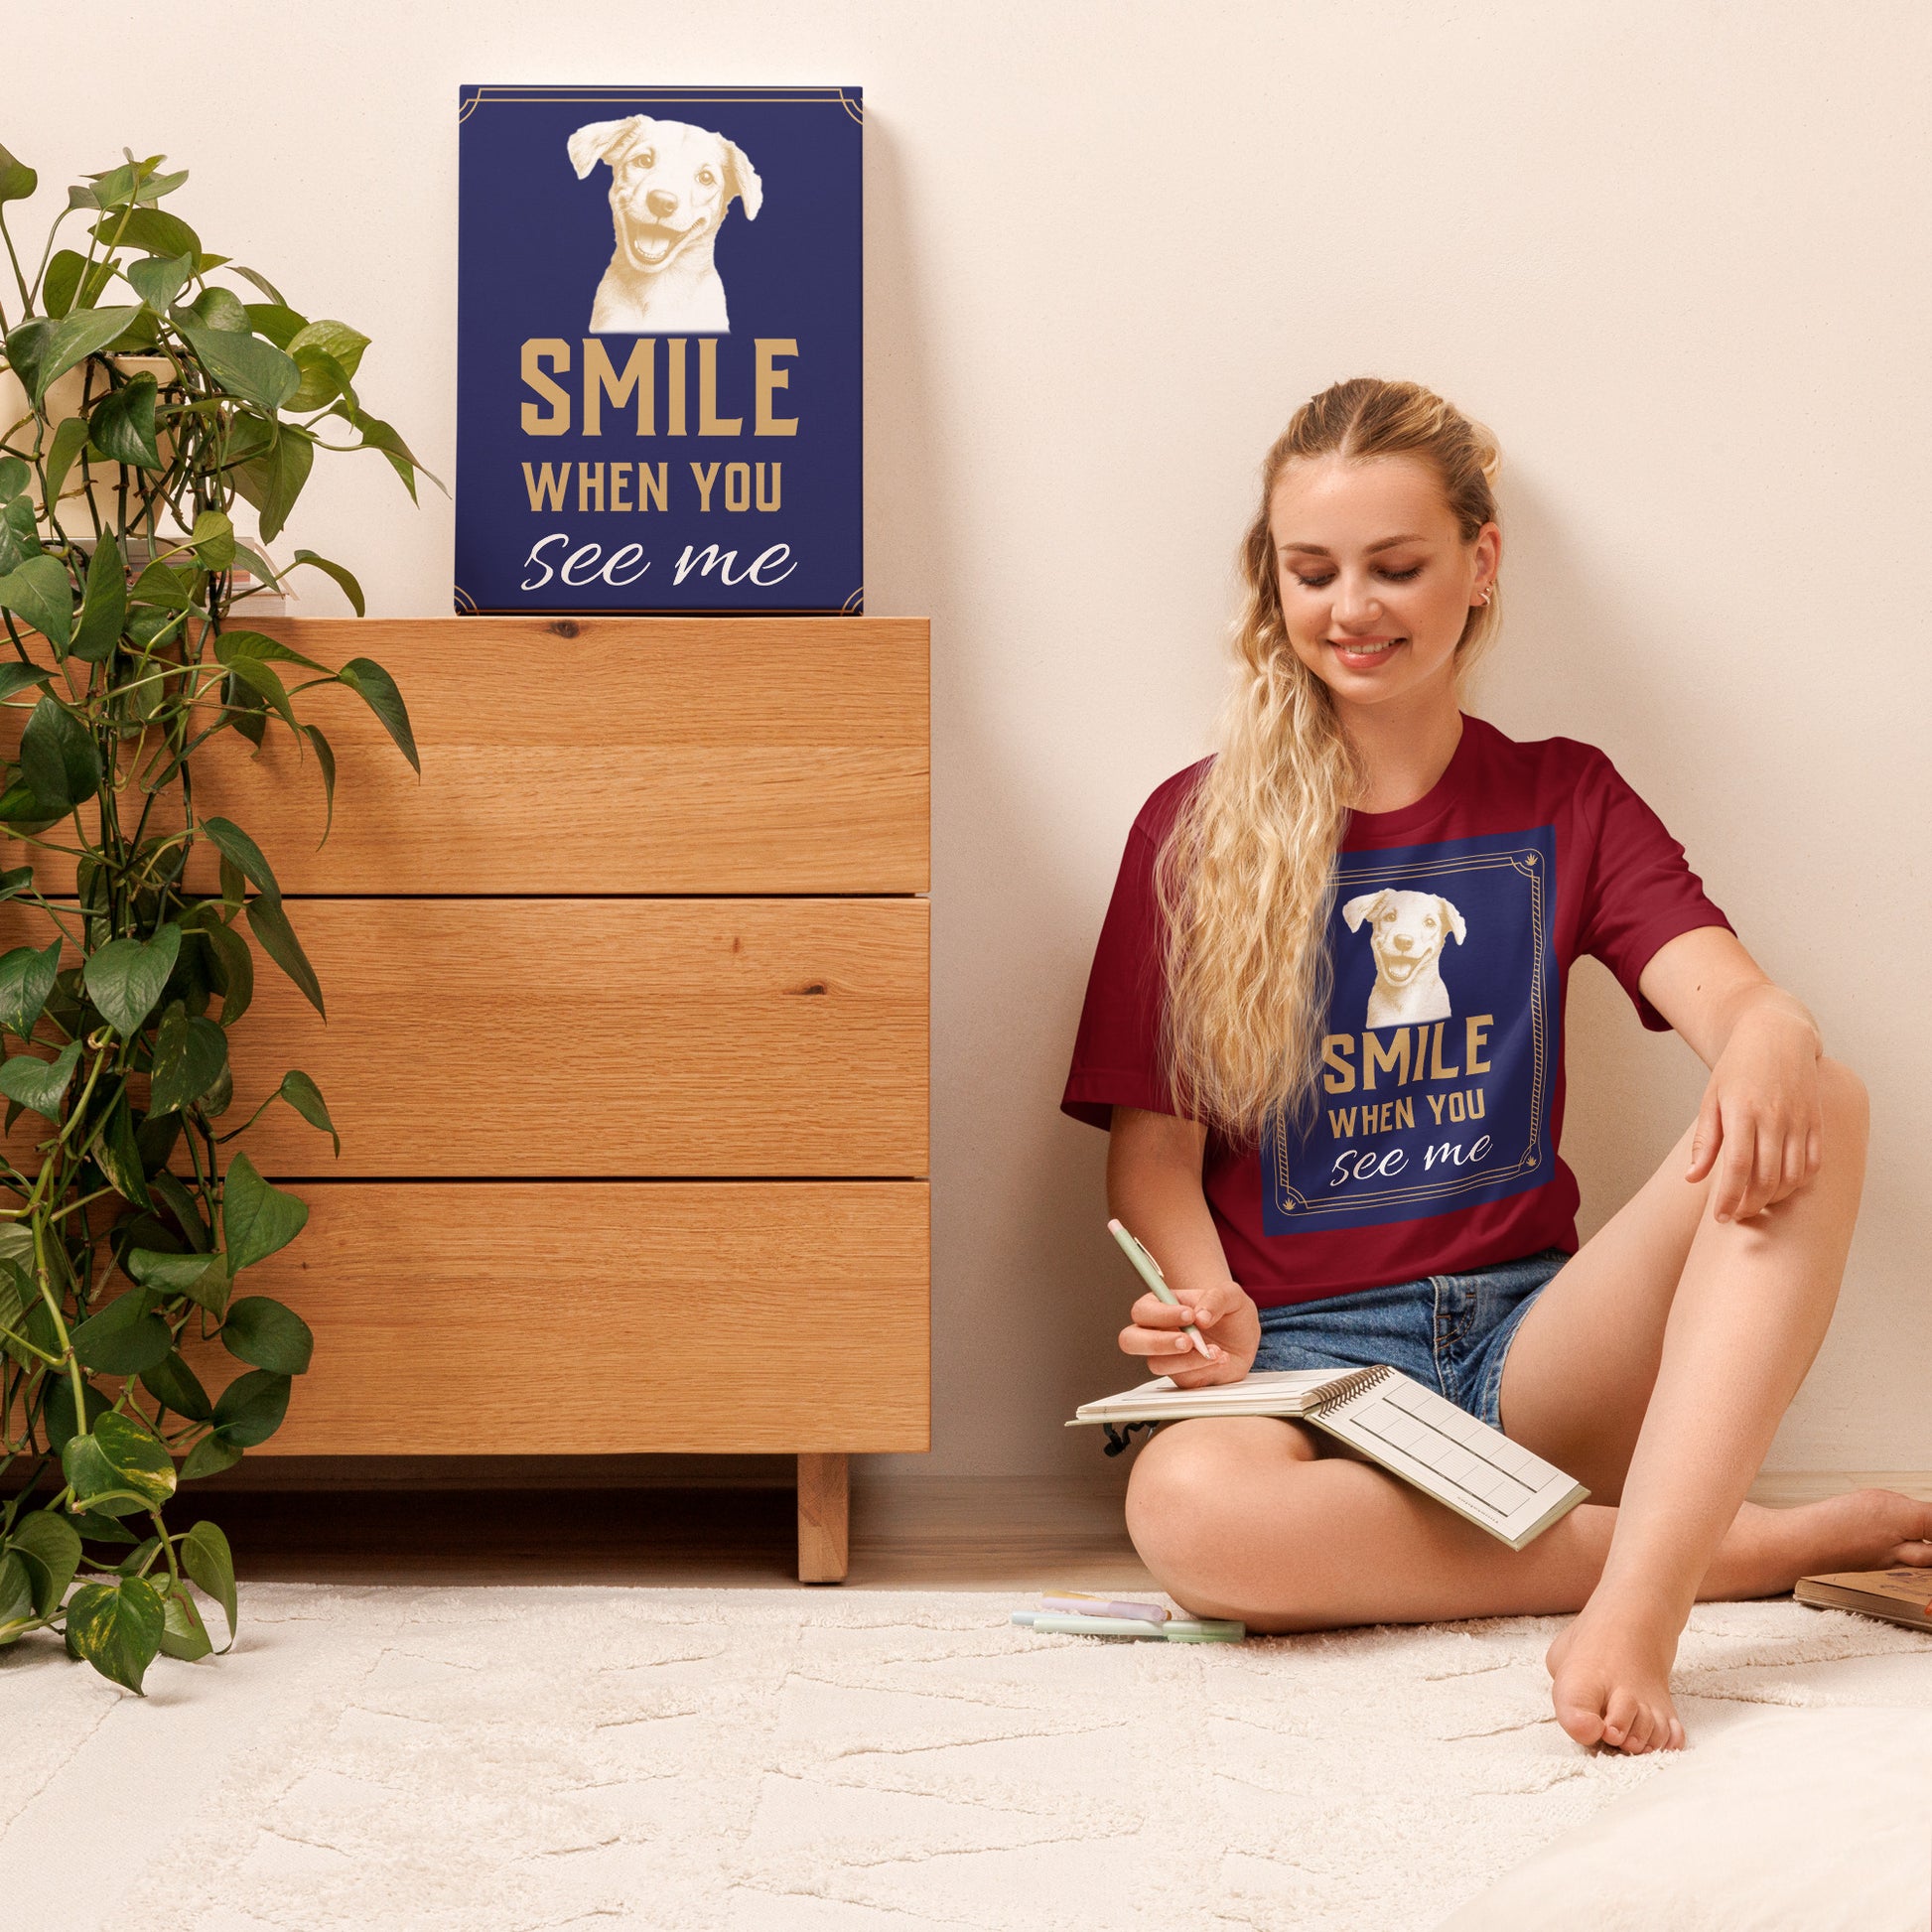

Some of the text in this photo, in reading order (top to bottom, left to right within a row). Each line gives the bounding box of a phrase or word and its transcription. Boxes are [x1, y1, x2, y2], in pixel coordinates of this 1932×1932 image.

[520, 338, 799, 436] SMILE
[521, 462, 782, 512] WHEN YOU
[520, 533, 798, 591] see me
[1321, 1014, 1494, 1095] SMILE
[1327, 1088, 1486, 1139] WHEN YOU
[1329, 1134, 1493, 1187] see me
